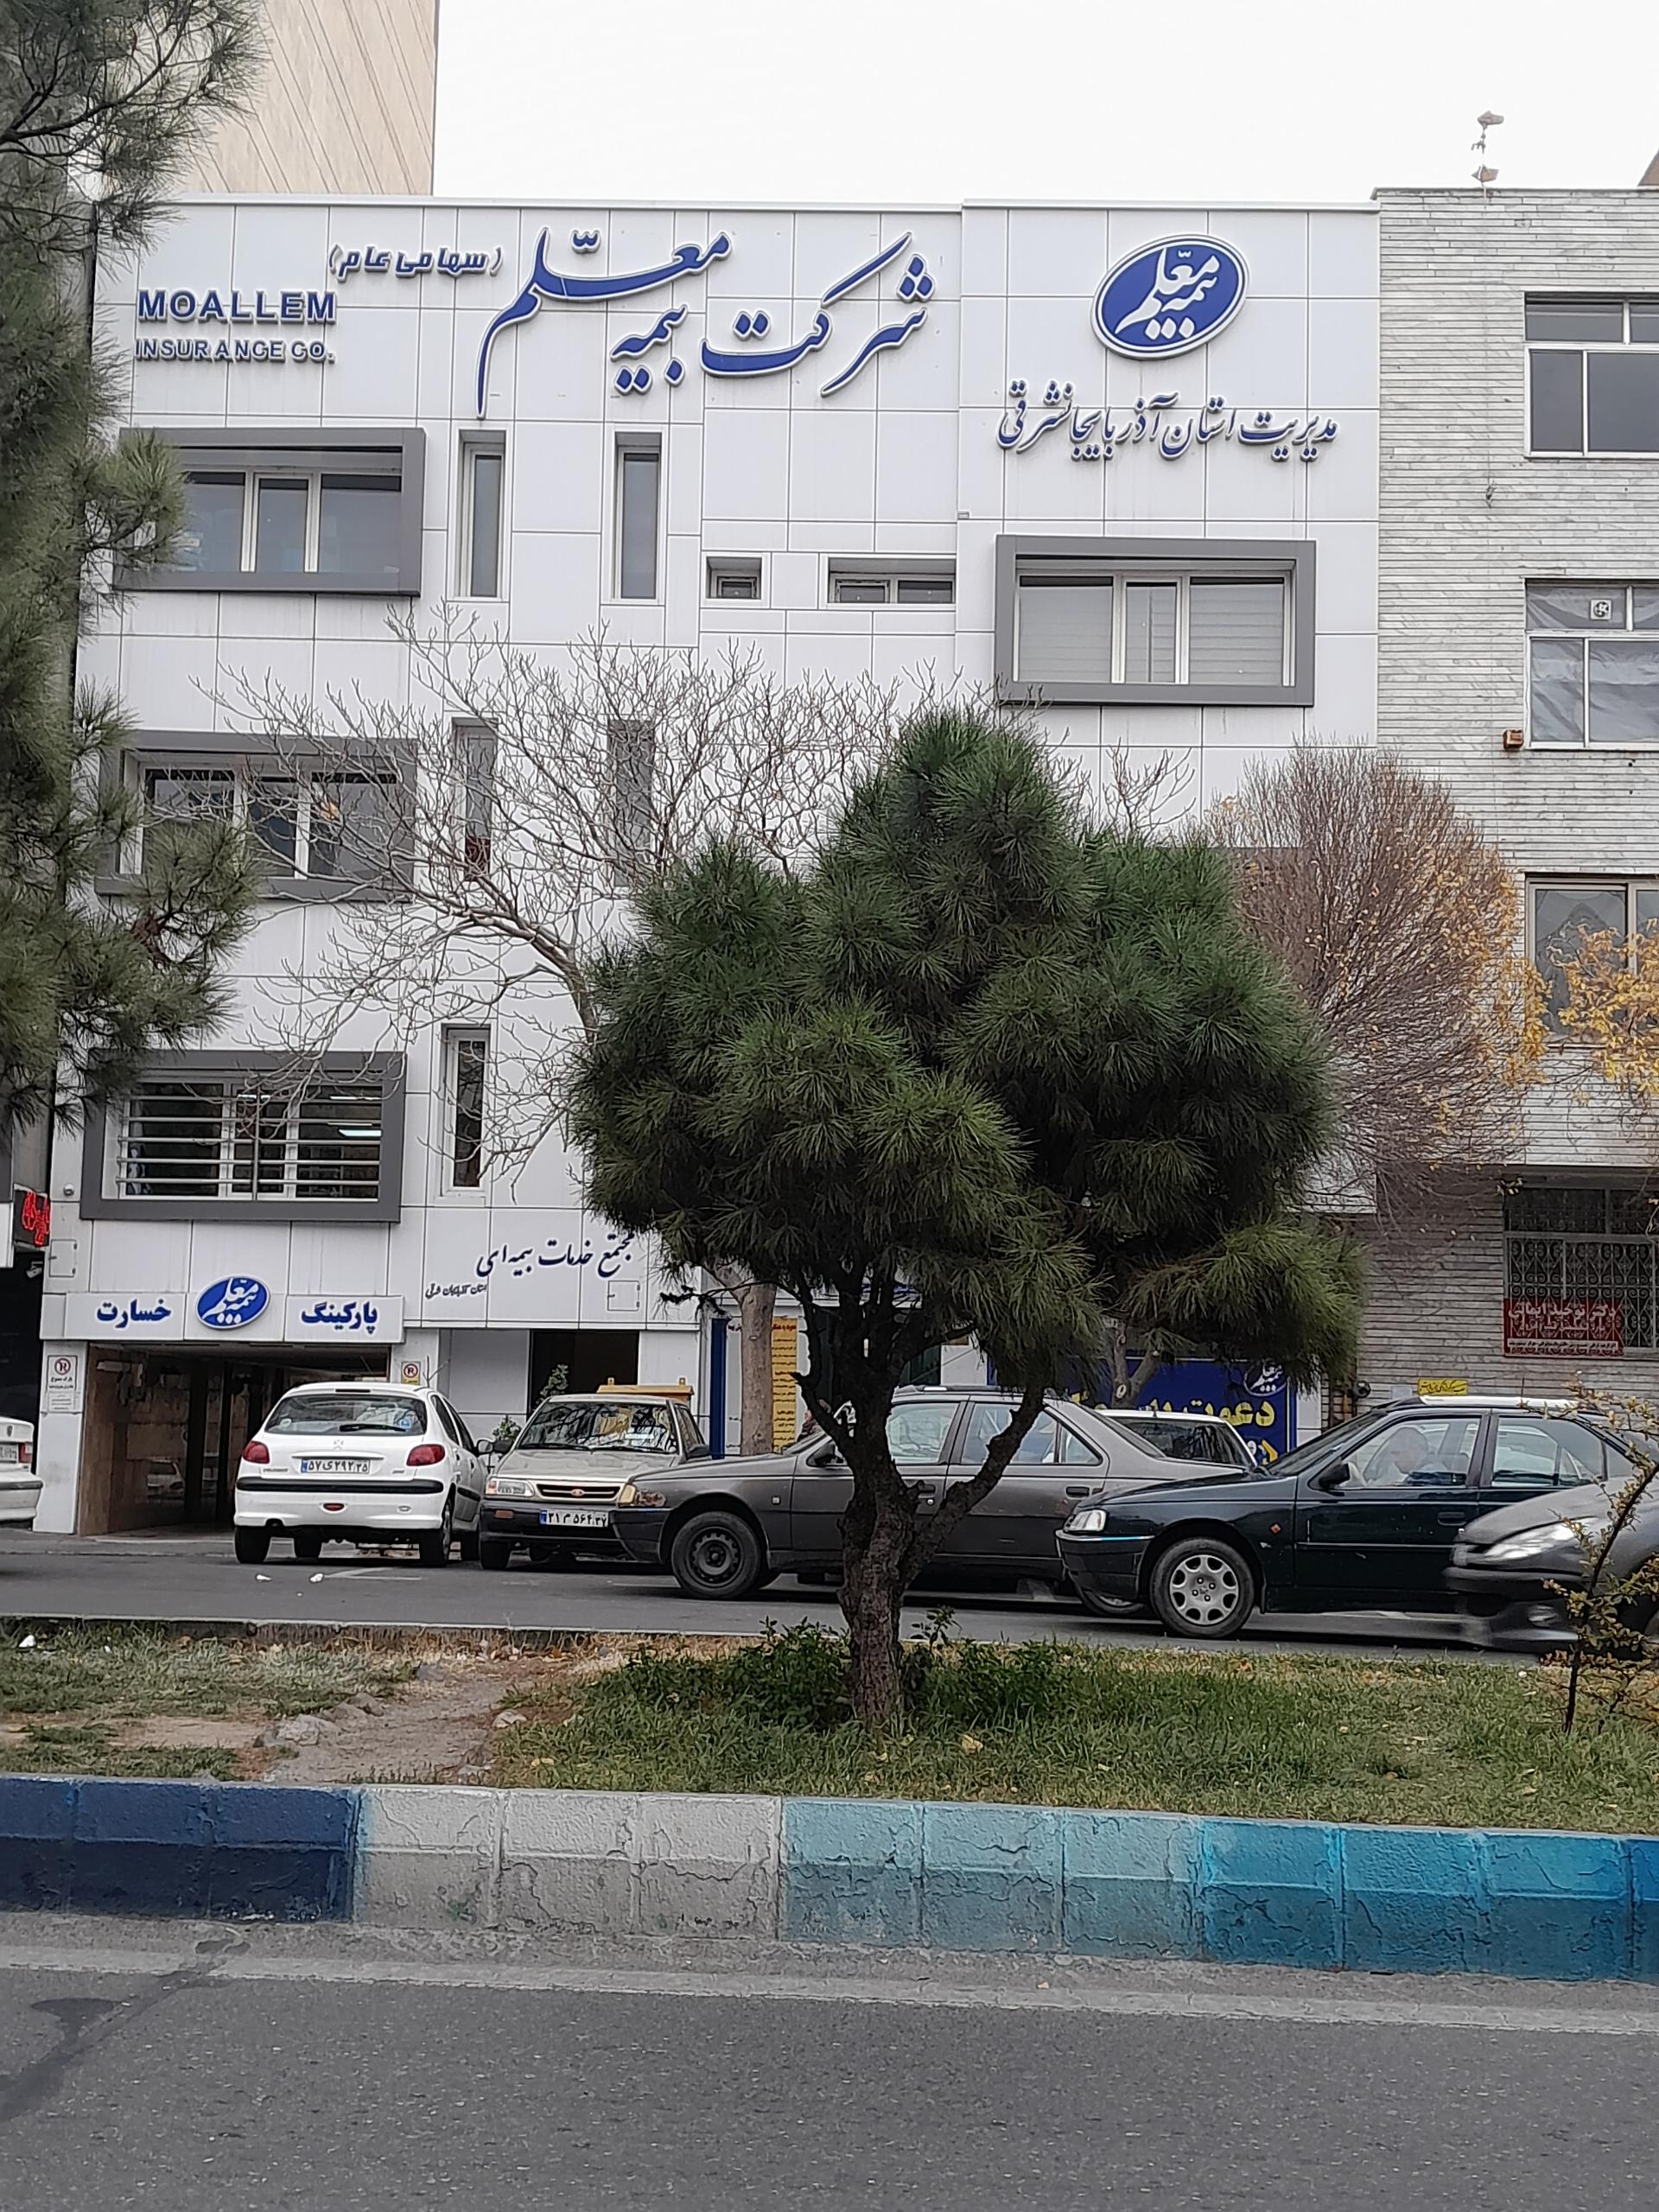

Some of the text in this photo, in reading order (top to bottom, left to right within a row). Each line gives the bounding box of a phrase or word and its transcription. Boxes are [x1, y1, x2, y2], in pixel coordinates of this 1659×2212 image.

[137, 289, 337, 325] MOALLEM
[700, 232, 935, 397] شرکت
[135, 338, 336, 365] INSURANCE CO.
[610, 303, 688, 396] بیمه
[1159, 396, 1238, 461] استان
[1238, 410, 1340, 462] مدیریت
[538, 1239, 594, 1266] خدمات
[96, 1299, 378, 1334] پارکینگ خسارت
